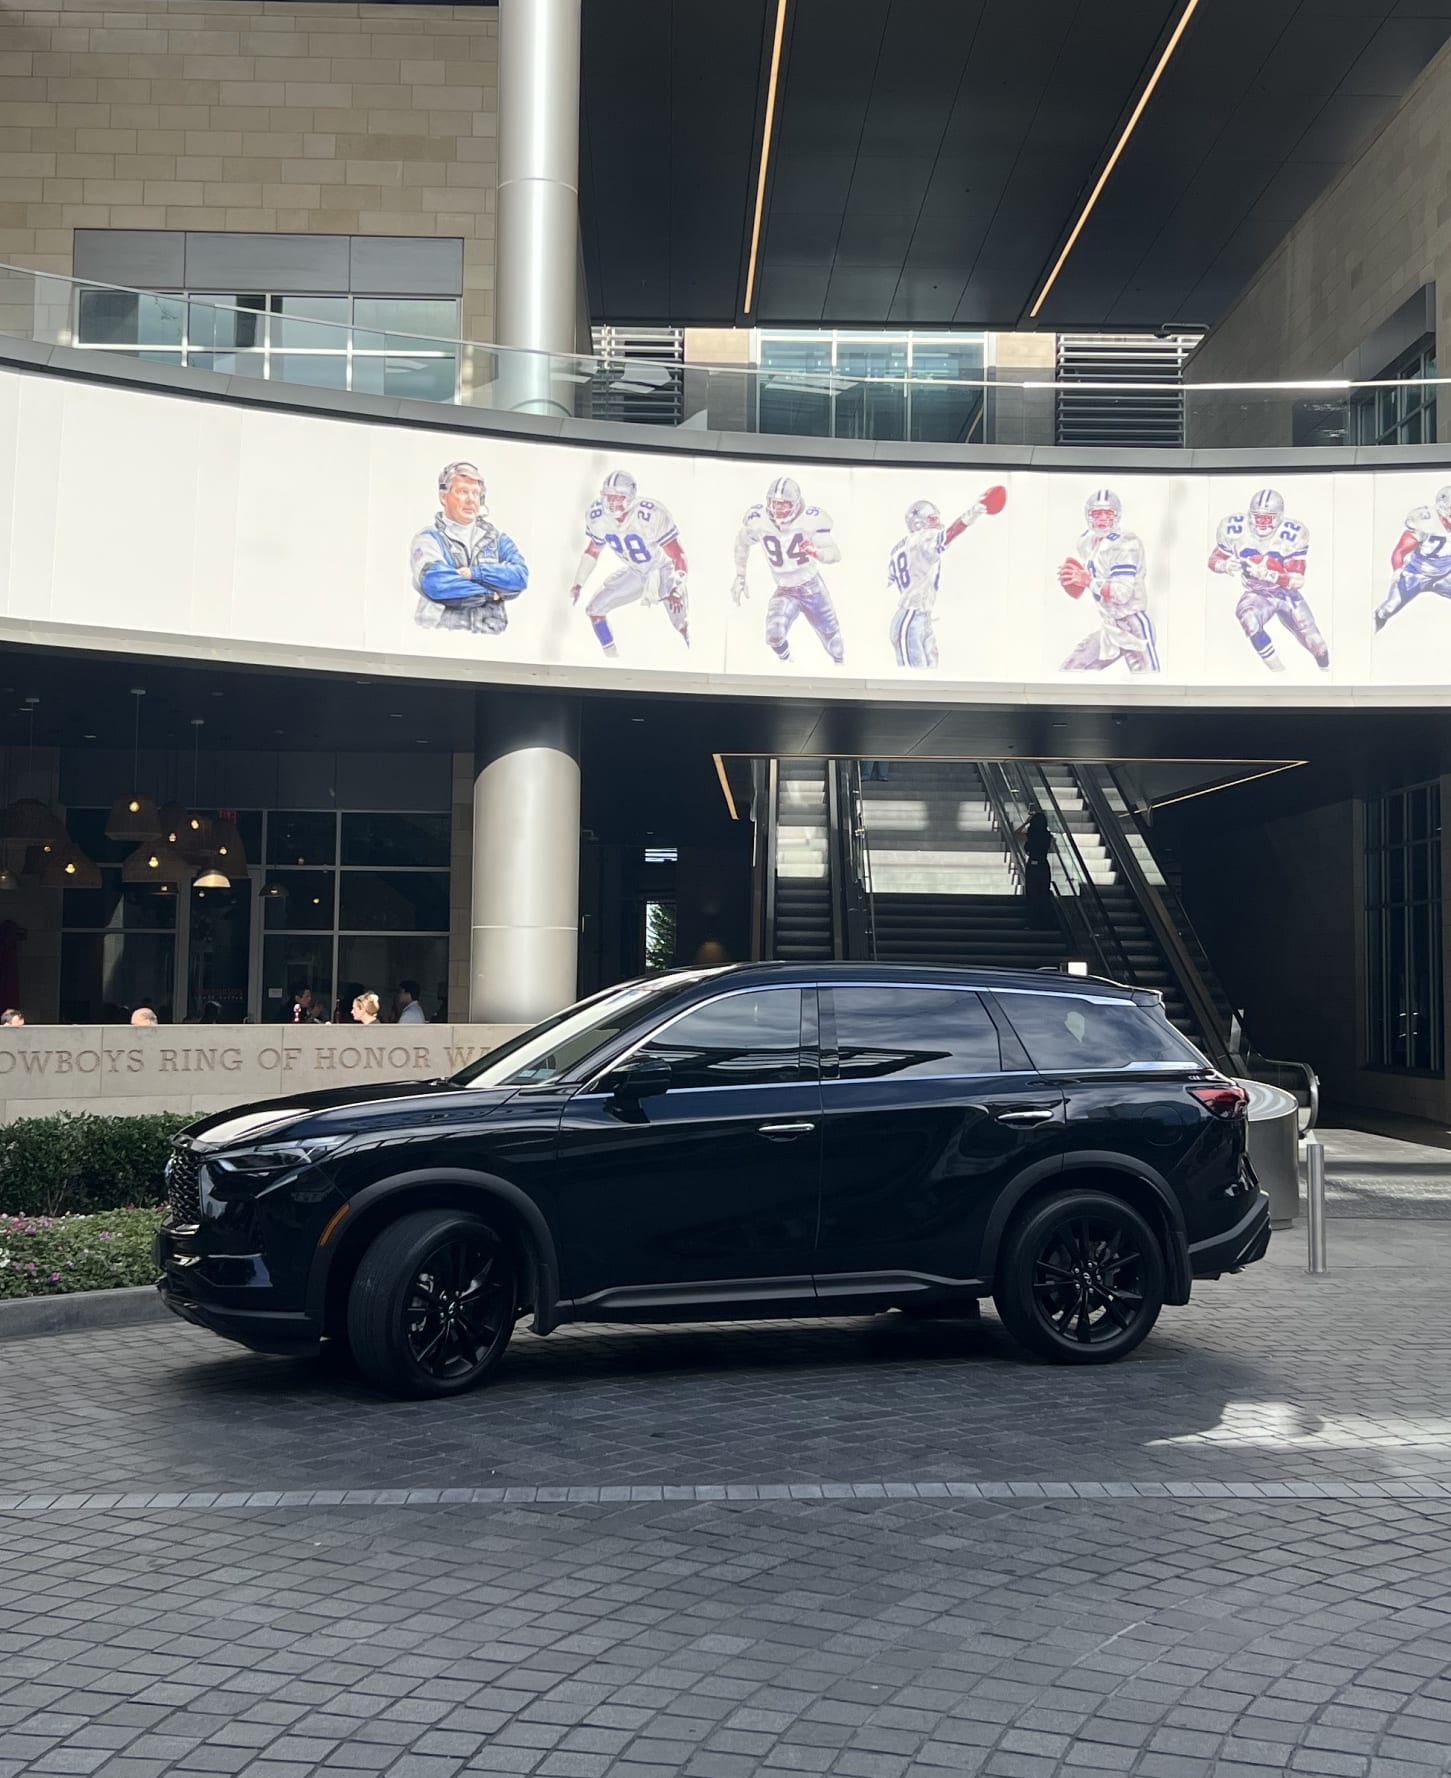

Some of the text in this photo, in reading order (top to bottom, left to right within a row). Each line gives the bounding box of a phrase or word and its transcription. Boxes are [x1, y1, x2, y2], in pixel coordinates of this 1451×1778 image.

[1280, 521, 1302, 542] 22
[763, 533, 810, 567] 94
[158, 1048, 243, 1072] RING
[257, 1047, 302, 1071] OF
[314, 1047, 431, 1070] HONOR
